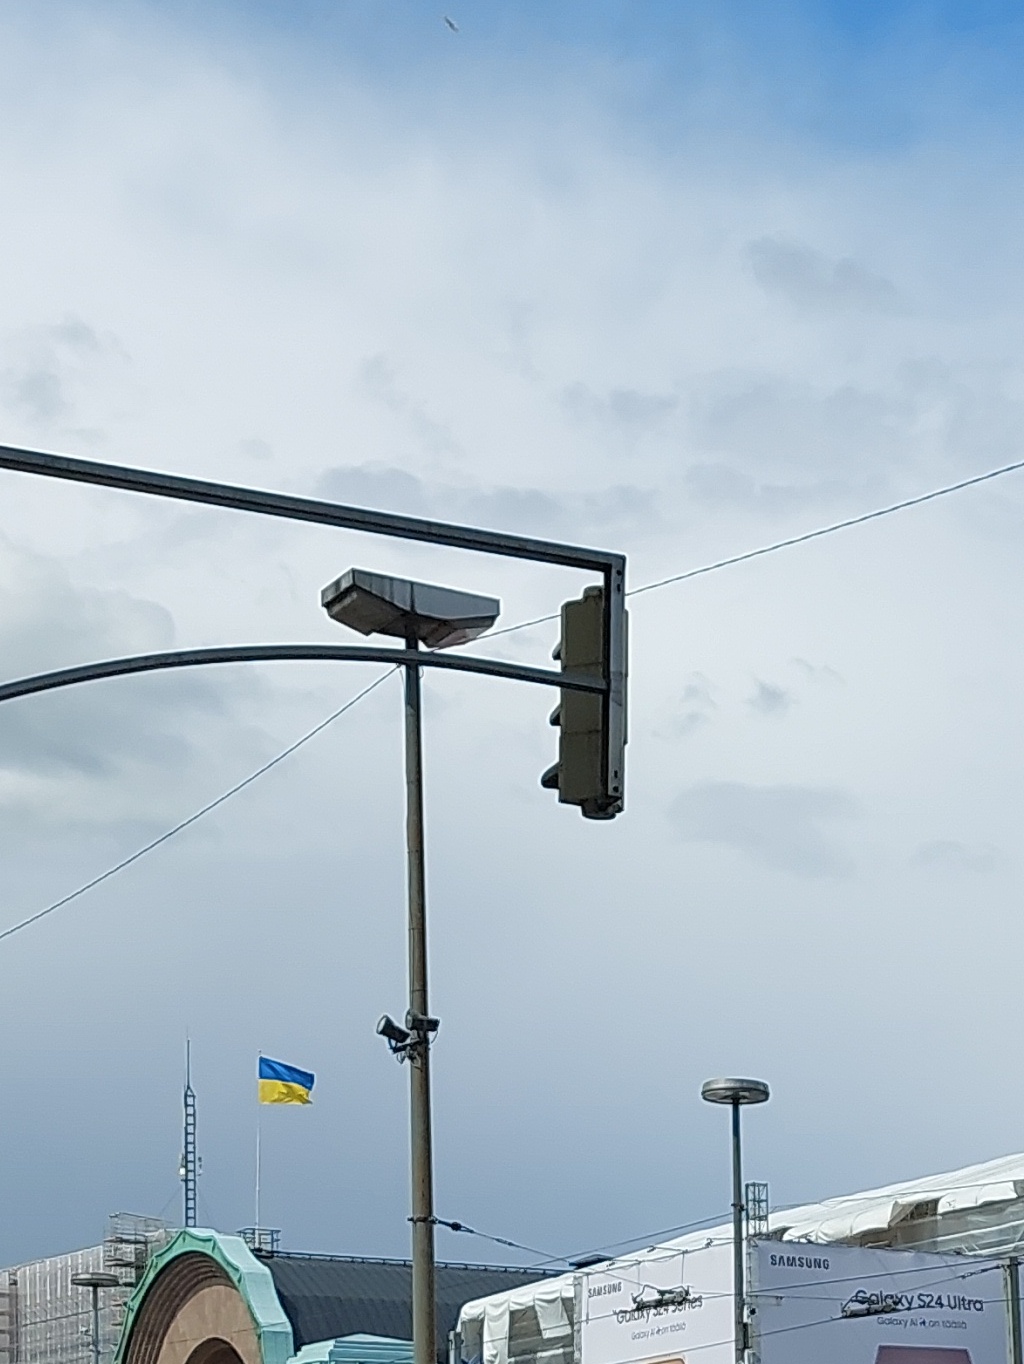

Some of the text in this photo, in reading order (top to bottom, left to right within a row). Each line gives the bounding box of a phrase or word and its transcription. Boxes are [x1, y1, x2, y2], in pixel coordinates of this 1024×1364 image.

[770, 1254, 830, 1270] SAMSUNG
[588, 1282, 622, 1298] SAMSUNG
[917, 1293, 944, 1309] S24
[947, 1294, 984, 1311] Ultra
